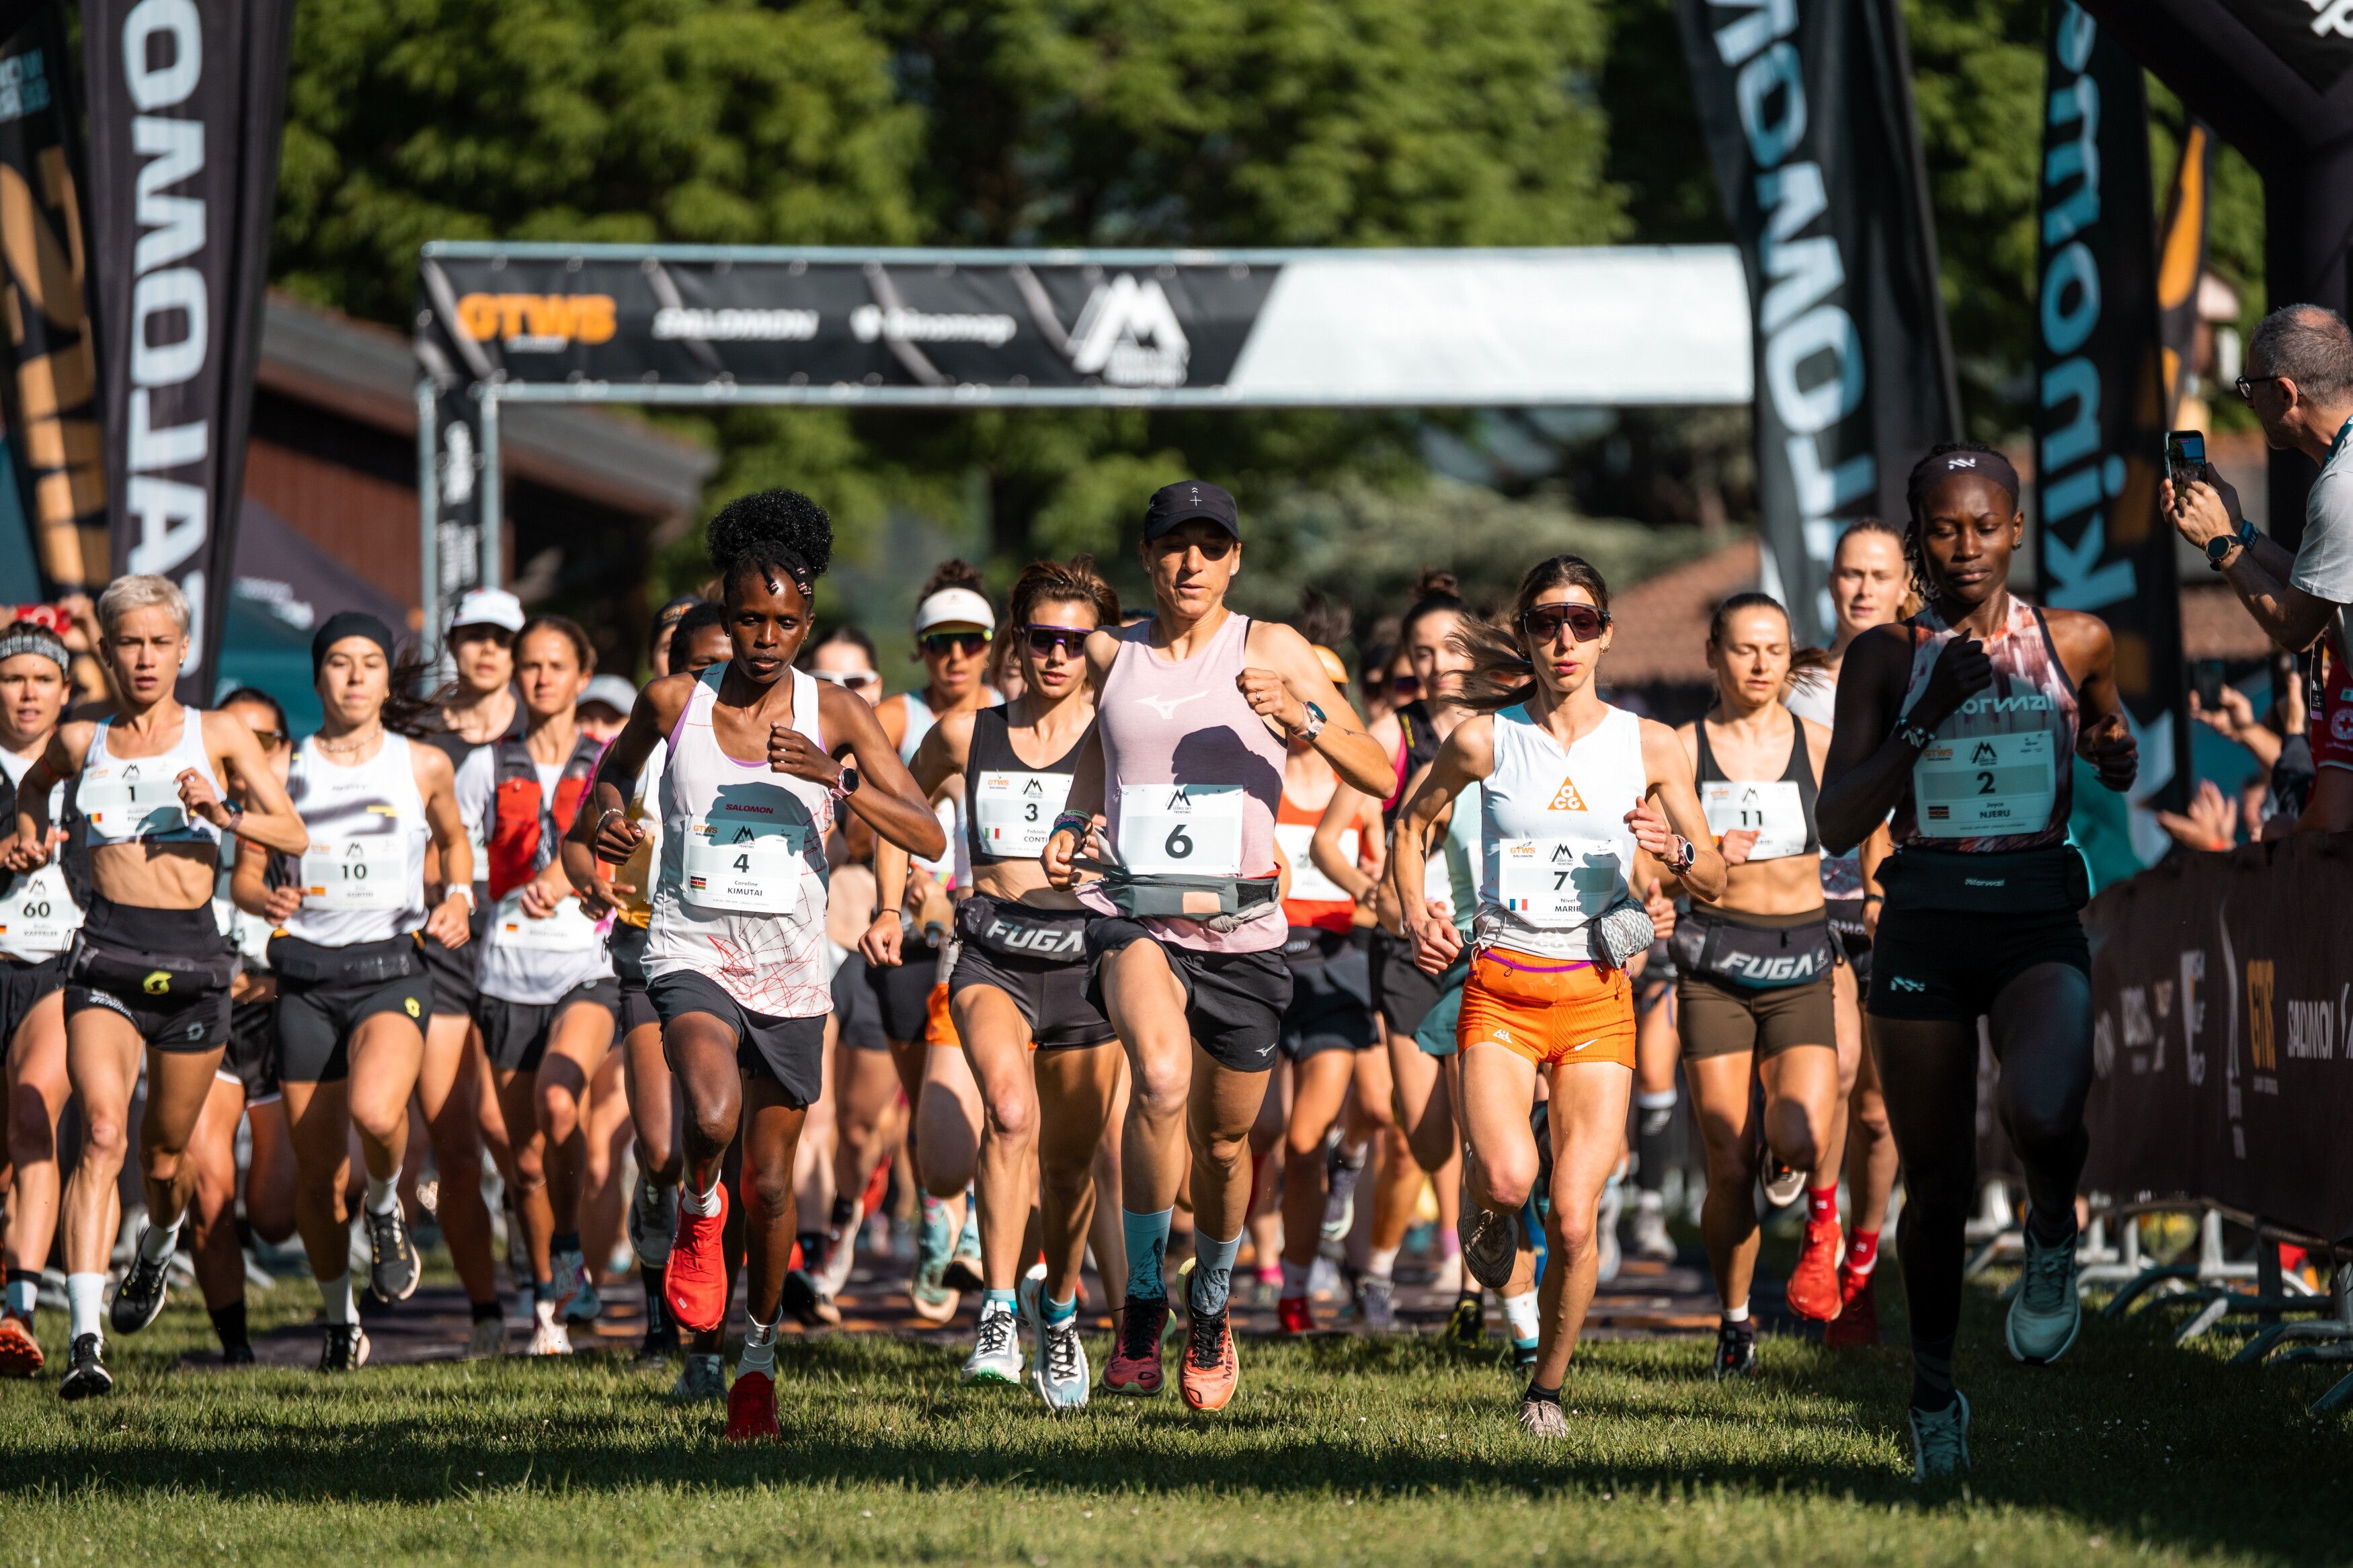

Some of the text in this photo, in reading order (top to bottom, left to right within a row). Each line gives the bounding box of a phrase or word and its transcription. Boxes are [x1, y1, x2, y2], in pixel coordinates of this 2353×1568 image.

[122, 0, 208, 677] ALOMO
[1977, 772, 1996, 795] 2
[128, 785, 136, 802] 1
[725, 804, 774, 814] SALOMON
[1025, 803, 1039, 822] 3
[1979, 810, 2010, 819] NJERU
[1741, 811, 1762, 826] 11
[693, 825, 718, 834] GTWS
[1165, 825, 1193, 859] 6
[342, 864, 367, 880] 10
[733, 854, 750, 874] 4
[1554, 872, 1570, 891] 7
[727, 887, 763, 897] KIMUTAI
[24, 902, 50, 918] 60
[1718, 951, 1814, 981] FUGA
